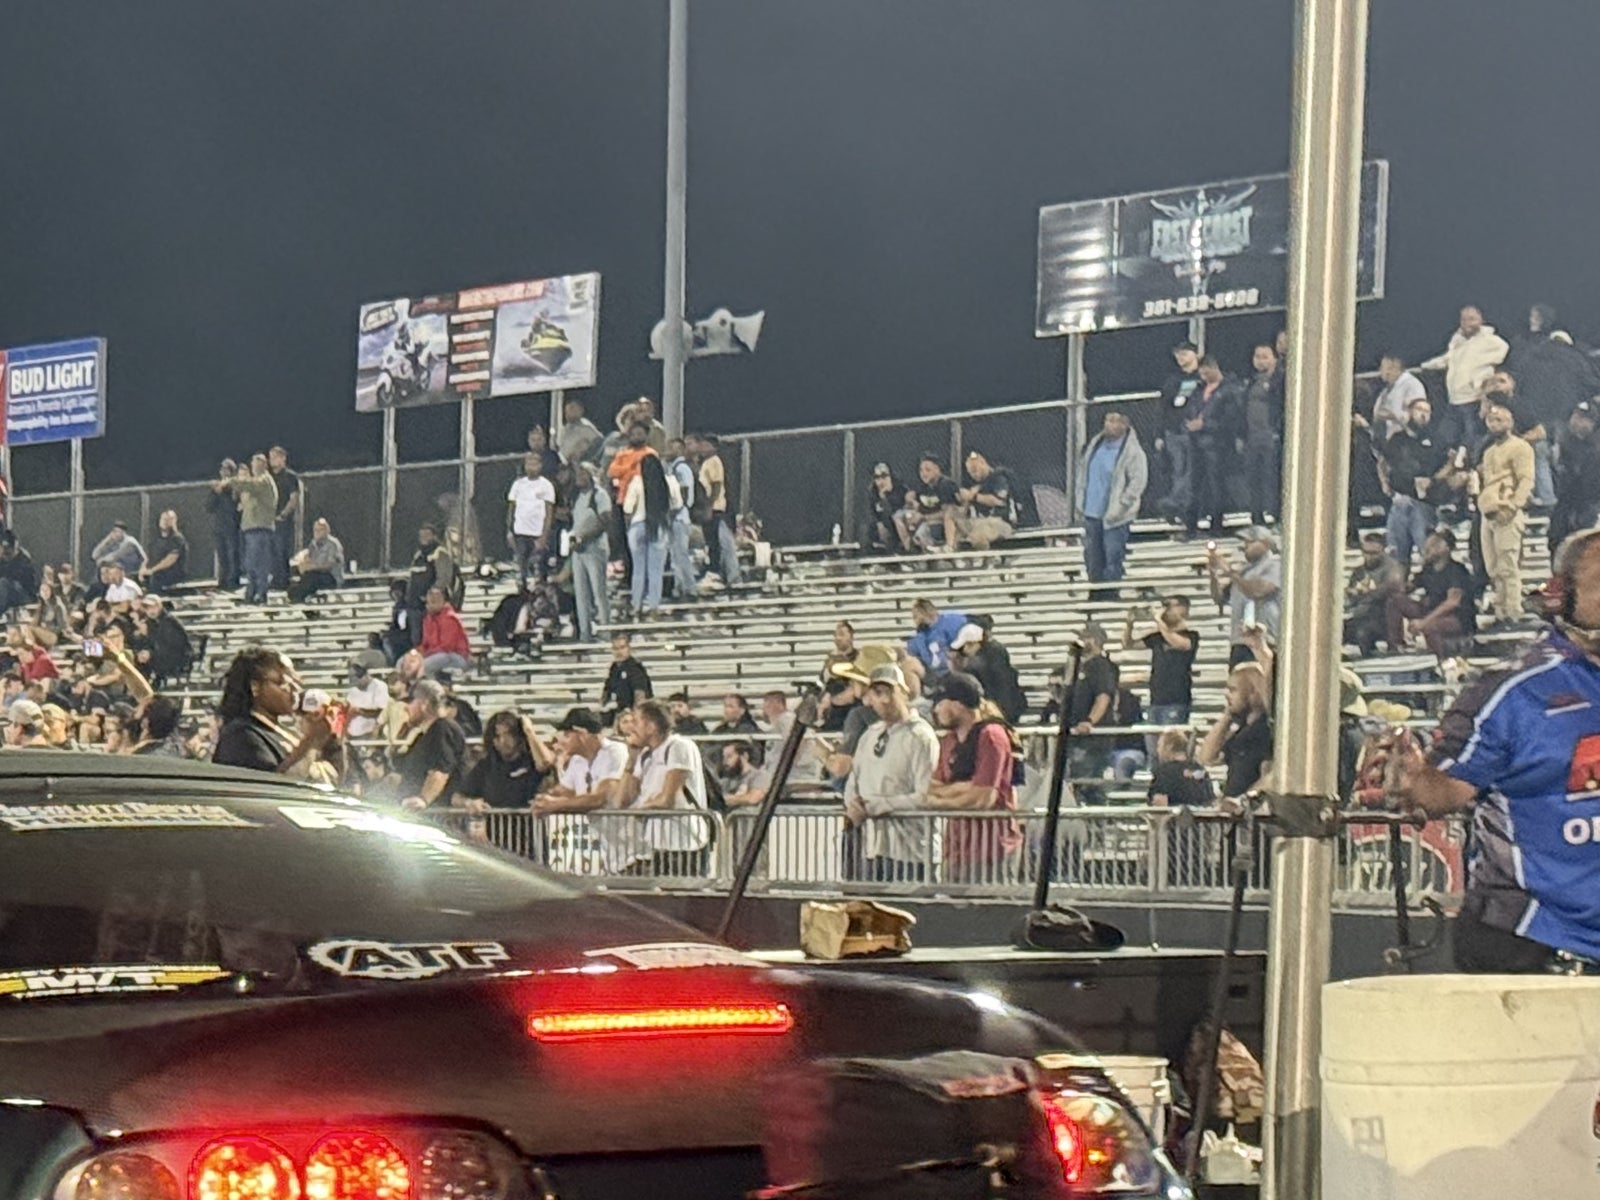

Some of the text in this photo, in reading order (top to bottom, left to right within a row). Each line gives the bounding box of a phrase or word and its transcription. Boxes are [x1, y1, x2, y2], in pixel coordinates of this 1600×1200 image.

[11, 359, 95, 395] BUD LIGHT
[345, 941, 511, 974] ATF
[26, 972, 166, 990] M/T
